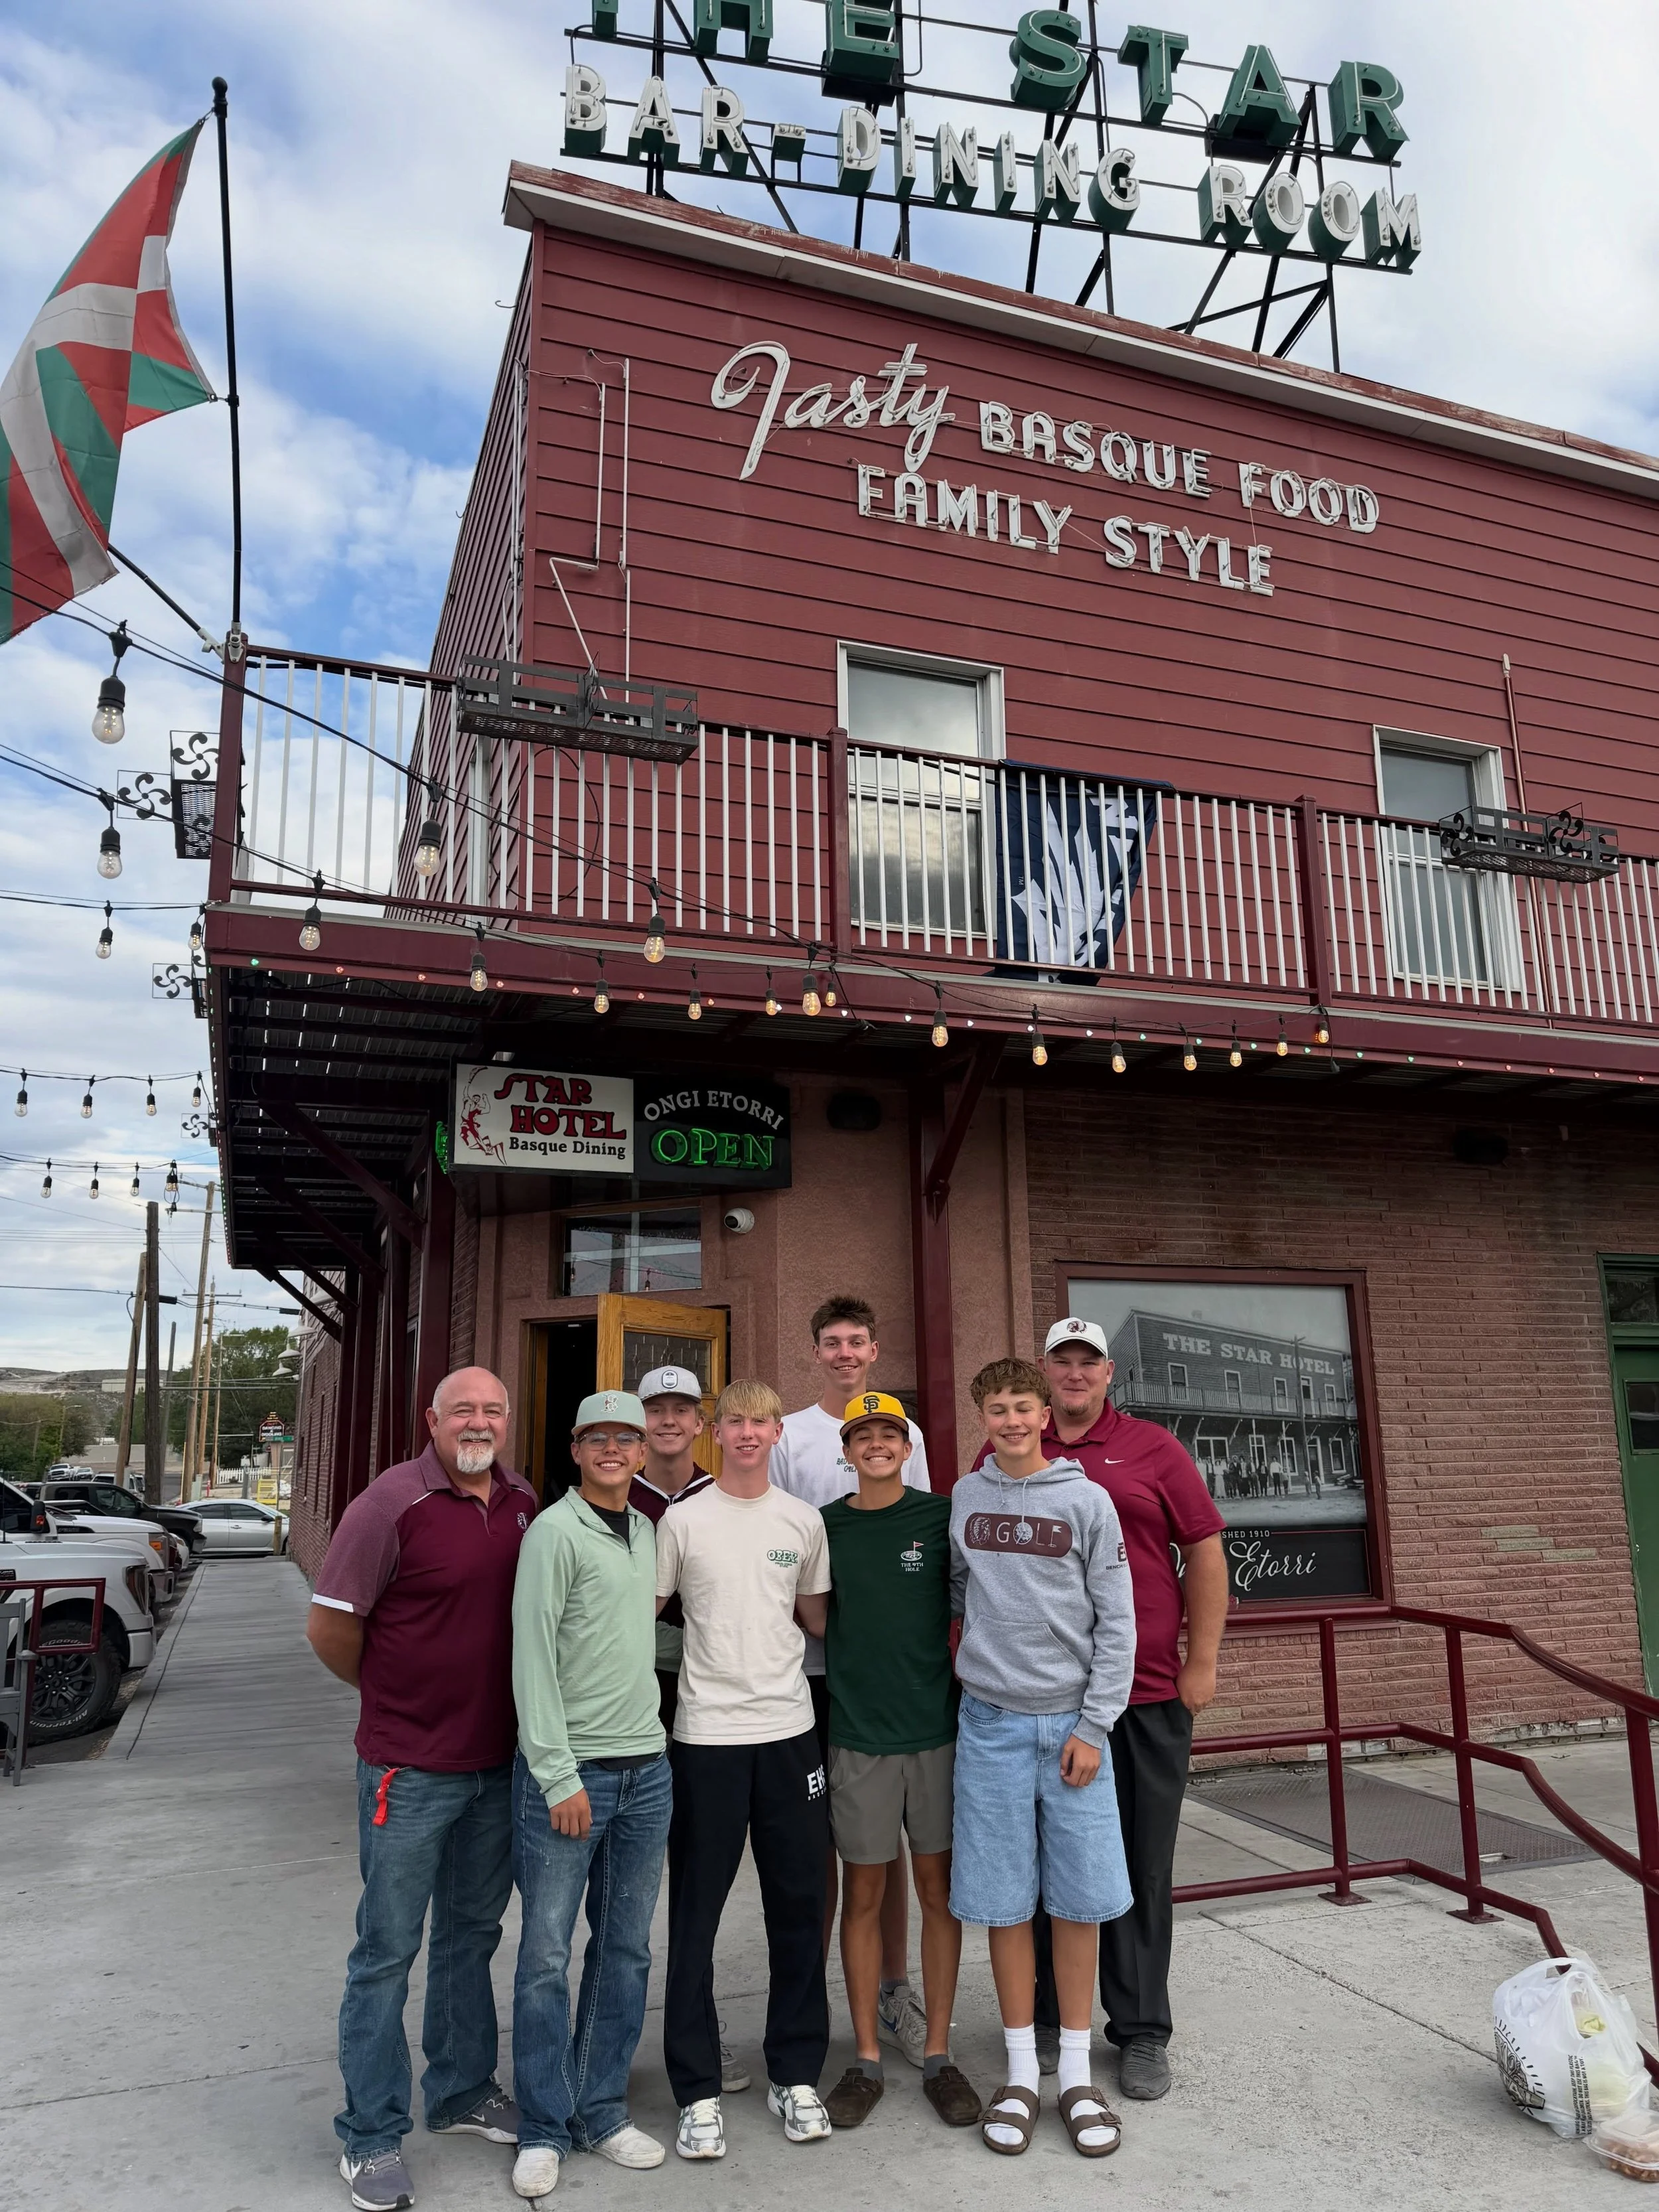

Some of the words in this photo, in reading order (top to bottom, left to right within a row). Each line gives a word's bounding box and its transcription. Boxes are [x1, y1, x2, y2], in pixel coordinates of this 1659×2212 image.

[1009, 9, 1411, 161] STAR
[1198, 165, 1421, 266] ROOM
[711, 340, 955, 481] Tasty
[979, 401, 1214, 498] BASQUE
[1239, 461, 1380, 533] FOOD
[857, 463, 1072, 555] FAMILY
[1104, 515, 1274, 596] STYLE
[494, 1073, 593, 1106] STAR
[644, 1090, 700, 1121] ONGI
[707, 1090, 784, 1130] ETORRI
[510, 1104, 627, 1140] HOTEL
[509, 1137, 567, 1155] Basque
[573, 1141, 626, 1160] Dining
[651, 1128, 775, 1171] OPEN
[1163, 1333, 1211, 1355] THE
[1220, 1343, 1273, 1365] STAR
[1279, 1353, 1335, 1375] HOTEL
[767, 1550, 798, 1564] OBEY
[1230, 1540, 1317, 1591] Etorri
